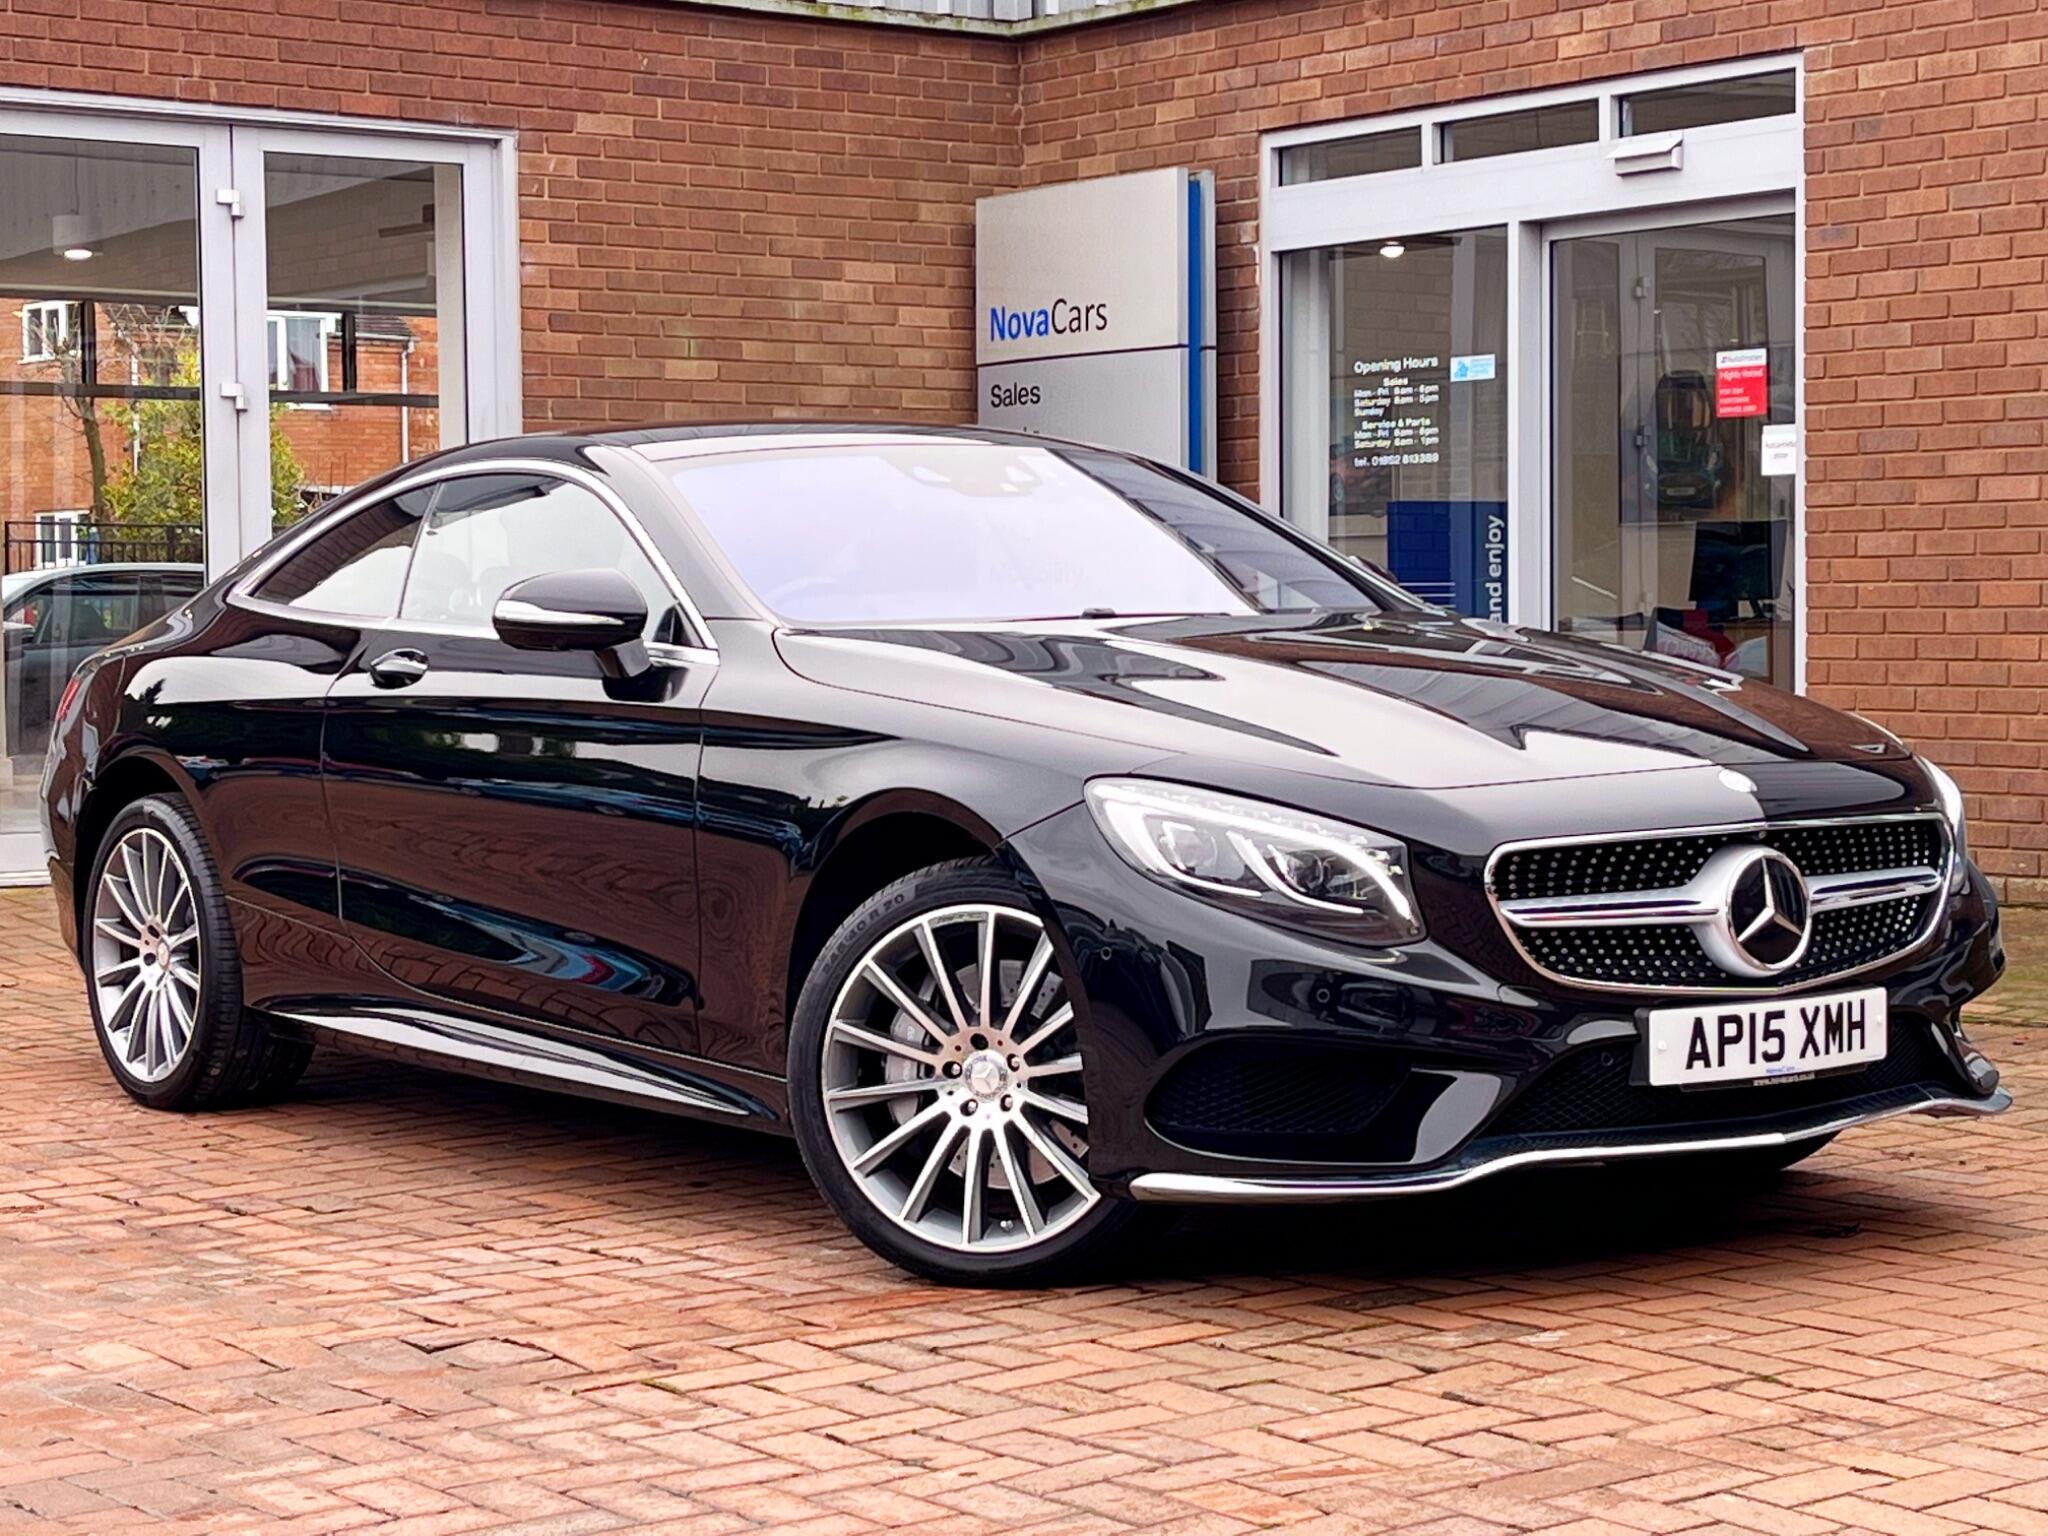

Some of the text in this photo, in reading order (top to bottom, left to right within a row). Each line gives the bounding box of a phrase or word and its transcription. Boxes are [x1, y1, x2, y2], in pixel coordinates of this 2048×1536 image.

[990, 298, 1107, 342] NovaCars
[1354, 357, 1439, 375] Opening Hours
[1383, 377, 1408, 386] Sales
[990, 382, 1041, 408] Sales
[1354, 397, 1391, 407] Saturday
[1354, 407, 1384, 417] Sunday
[1362, 419, 1396, 430] Service
[1405, 417, 1431, 426] Parts
[1354, 440, 1392, 449] Saturday
[1485, 515, 1505, 623] and enjoy
[1685, 998, 1865, 1070] AP15 XMH
